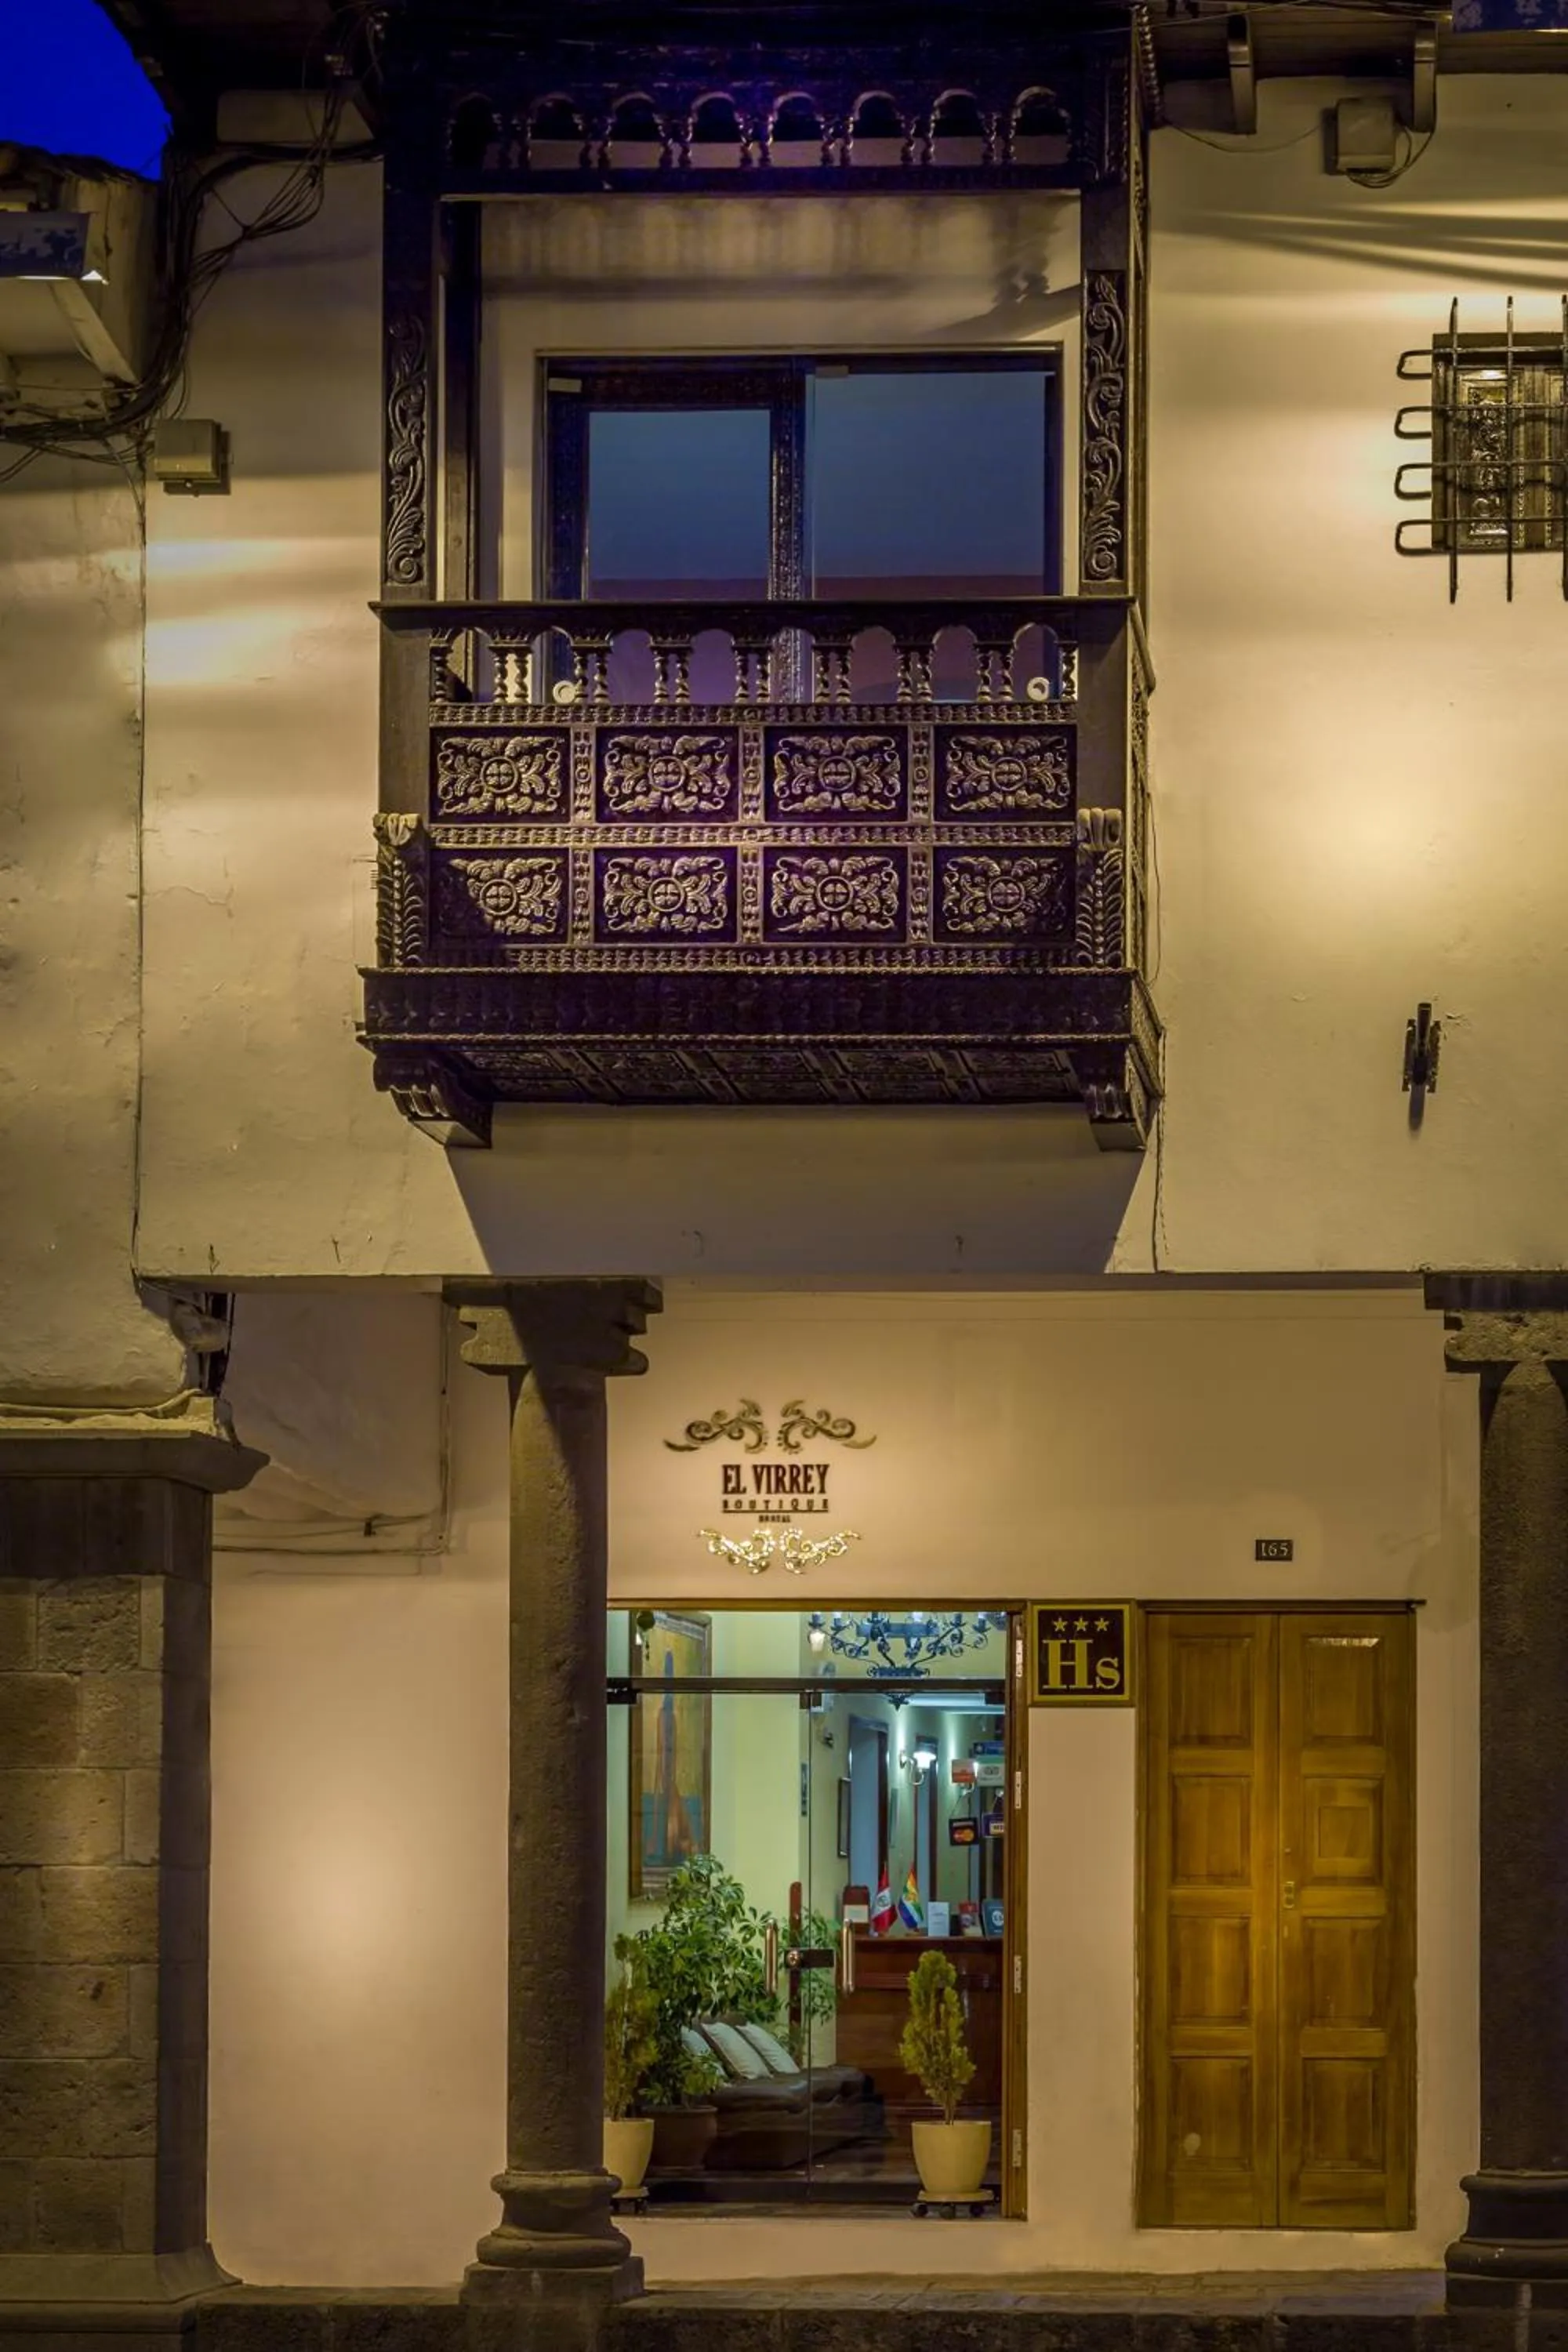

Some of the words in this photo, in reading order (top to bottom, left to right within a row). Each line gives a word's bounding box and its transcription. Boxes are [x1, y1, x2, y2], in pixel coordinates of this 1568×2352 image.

[722, 1464, 746, 1494] EL
[752, 1464, 829, 1494] VIRREY
[722, 1498, 829, 1510] BOUTIQUE
[1261, 1542, 1289, 1556] 165
